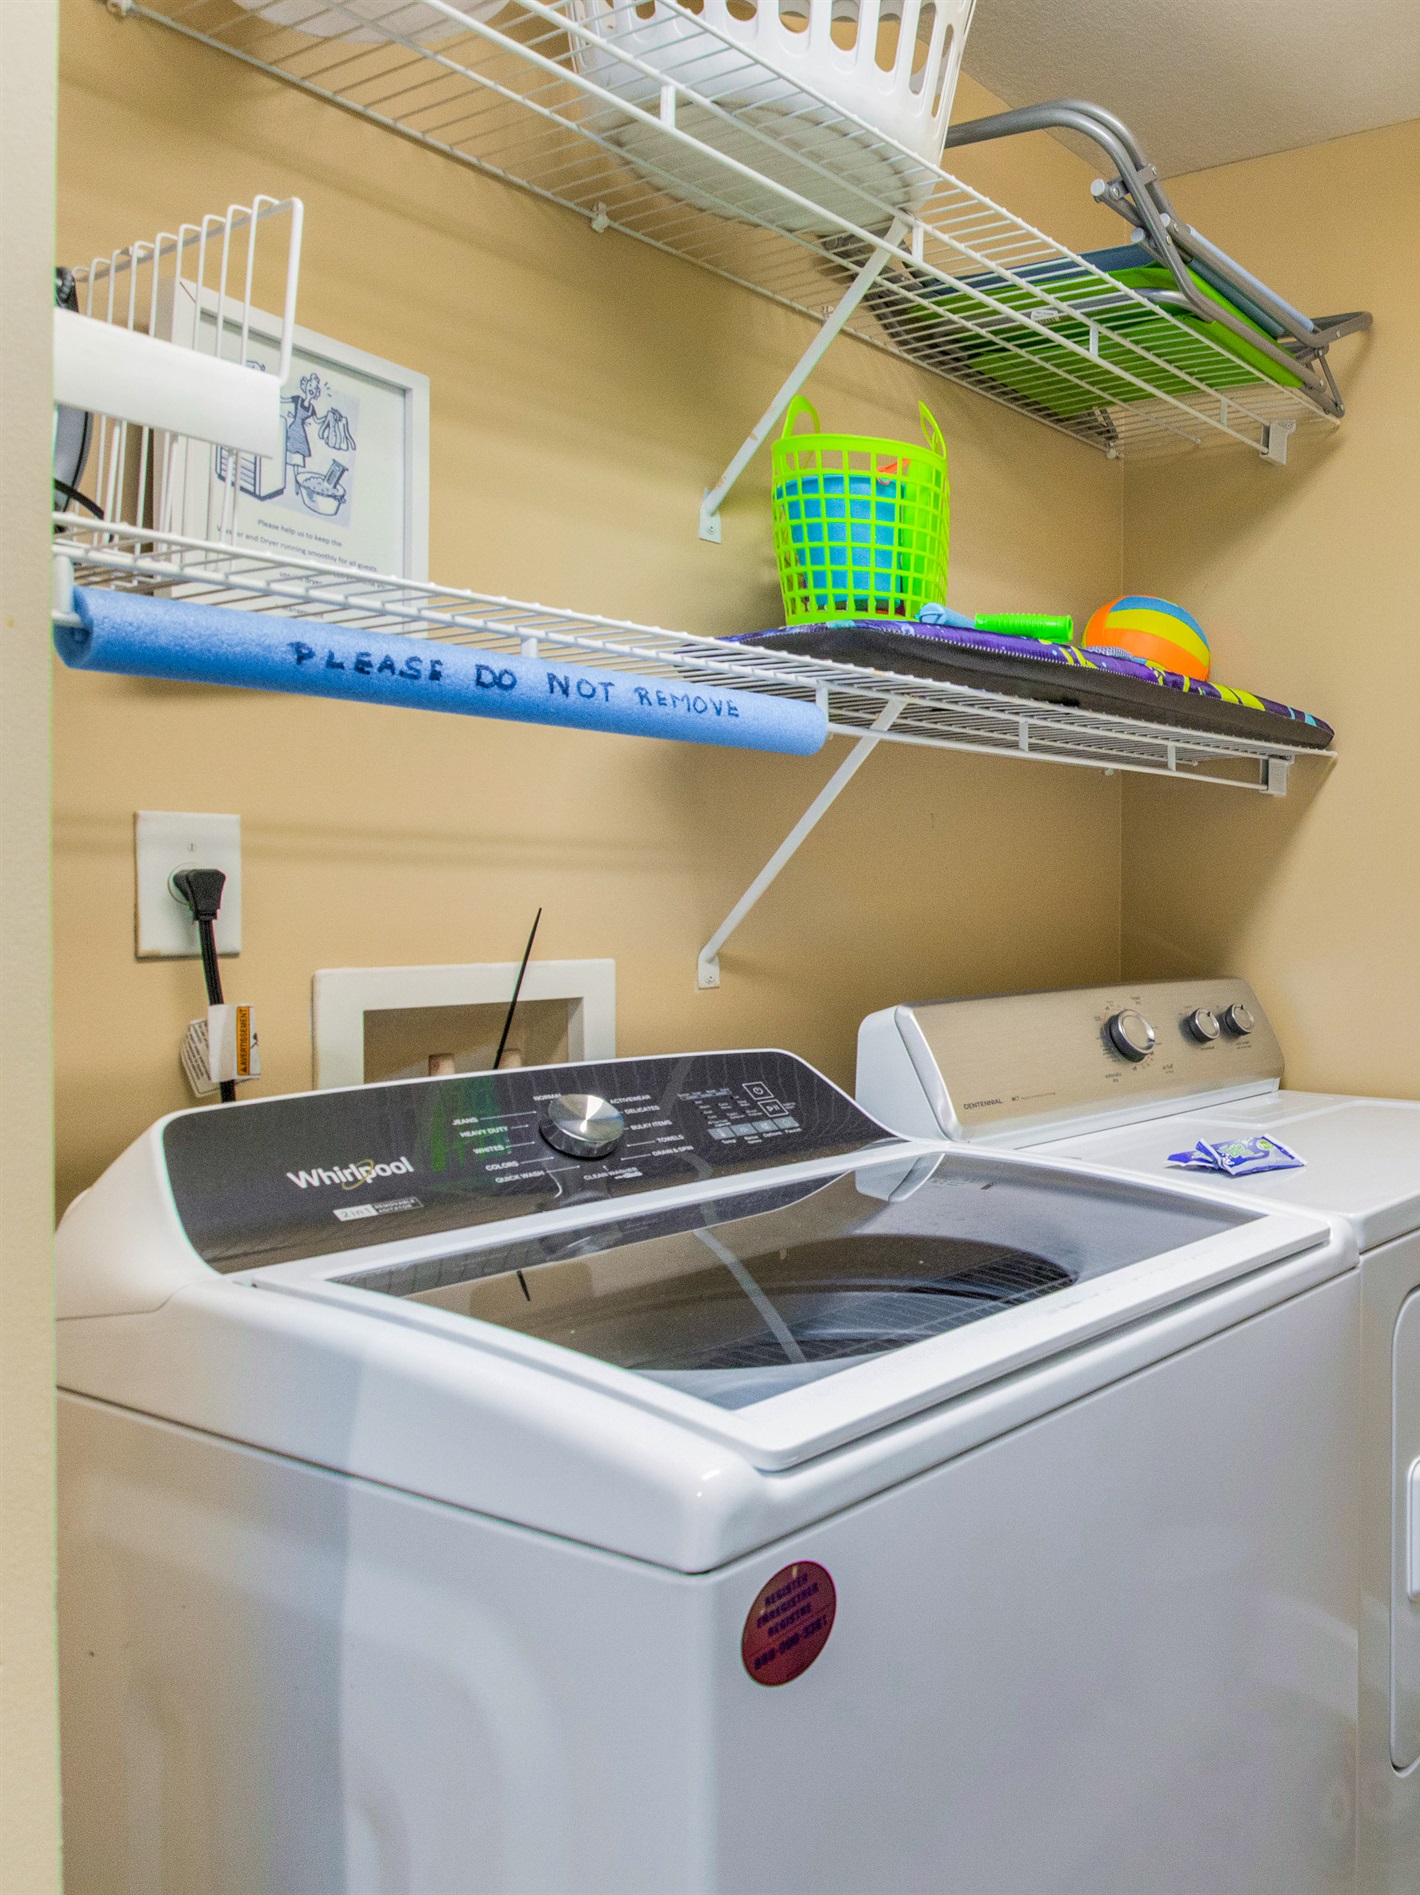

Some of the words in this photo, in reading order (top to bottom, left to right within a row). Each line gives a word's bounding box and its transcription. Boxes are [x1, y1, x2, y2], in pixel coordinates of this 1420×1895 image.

[257, 518, 280, 532] Please
[280, 525, 296, 536] help
[306, 531, 313, 540] to
[314, 534, 330, 545] keep
[331, 538, 343, 548] the
[245, 532, 259, 542] and
[260, 536, 279, 548] Dryer
[280, 543, 307, 556] running
[307, 549, 338, 563] smoothly
[338, 556, 348, 565] for
[349, 558, 357, 567] all
[357, 562, 377, 573] guests
[287, 641, 443, 681] PLEASE
[474, 663, 518, 691] DO
[546, 671, 615, 702] NOT
[633, 685, 740, 718] REMOVE
[239, 1008, 248, 1067] AVERTISSEMENT
[610, 1094, 652, 1104] ACTIVEWEAR
[963, 1098, 1004, 1110] CENTENNIAL
[624, 1105, 661, 1115] DELICATES
[452, 1117, 478, 1126] JEANS
[630, 1122, 652, 1131] BULKY
[652, 1119, 673, 1128] ITEMS
[459, 1128, 486, 1138] HEAVY
[486, 1125, 508, 1135] DUTY
[656, 1134, 685, 1143] TOWELS
[473, 1144, 505, 1155] WHITES
[485, 1160, 520, 1172] COLORS
[285, 1155, 415, 1190] Whirlpool
[495, 1173, 521, 1184] QUICK
[521, 1169, 546, 1179] WASH
[583, 1171, 608, 1181] CLEAN
